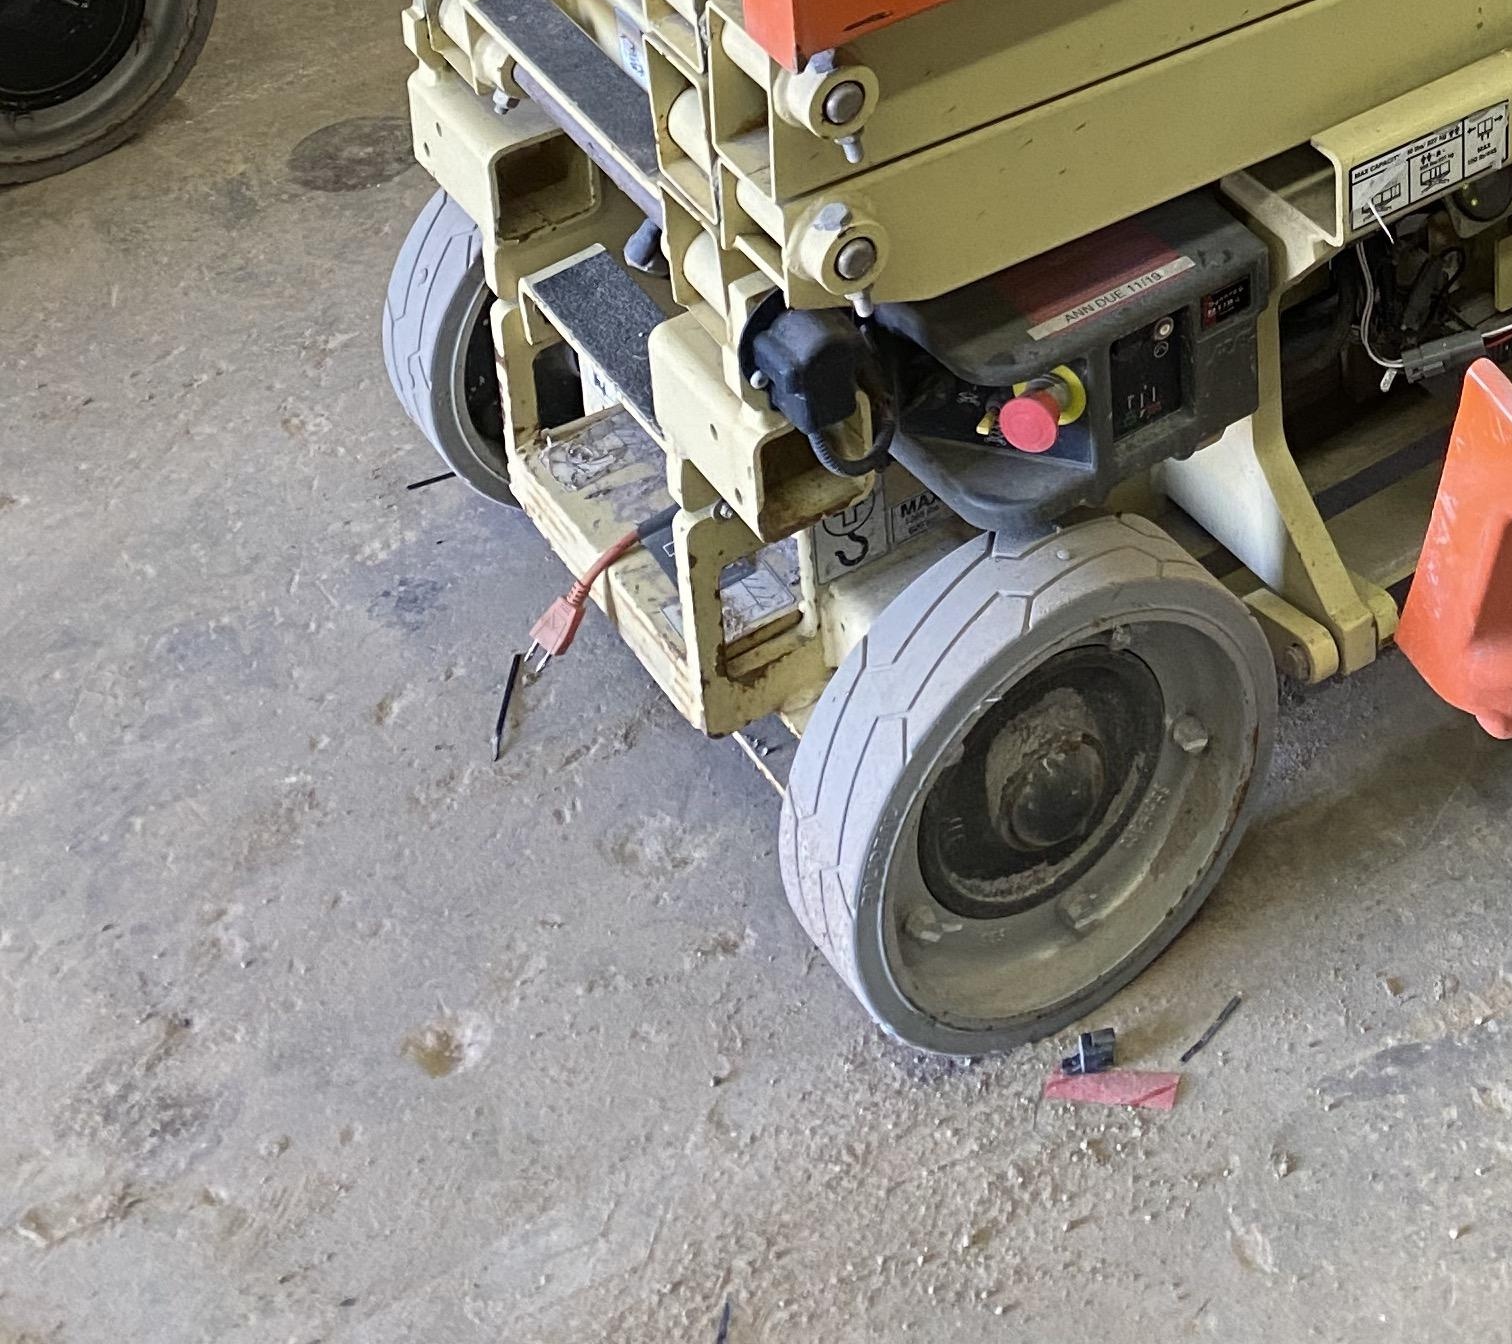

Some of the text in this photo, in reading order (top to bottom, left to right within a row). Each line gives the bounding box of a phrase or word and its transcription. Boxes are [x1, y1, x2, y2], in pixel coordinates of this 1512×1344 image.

[1354, 167, 1369, 180] MAX
[1064, 271, 1162, 324] ANN DUE 11/19
